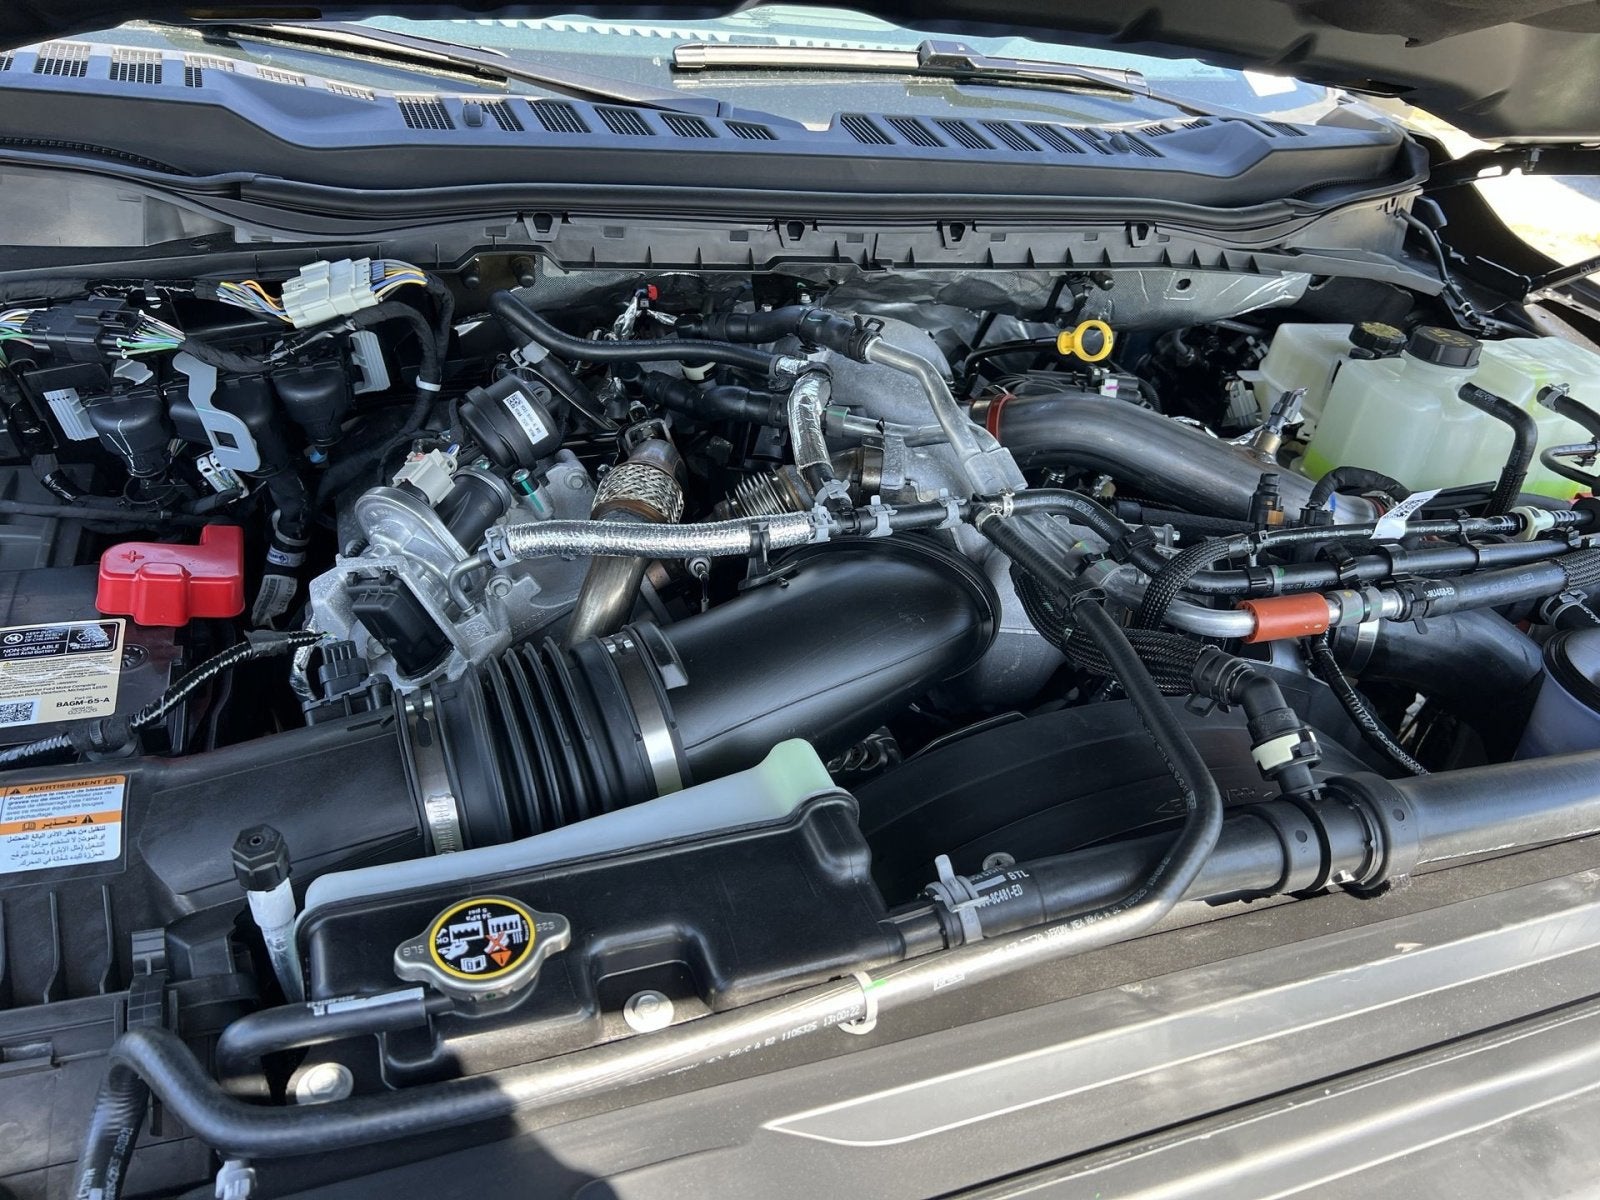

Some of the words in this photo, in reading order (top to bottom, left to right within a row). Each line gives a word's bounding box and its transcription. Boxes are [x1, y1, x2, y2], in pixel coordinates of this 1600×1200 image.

[3, 643, 60, 654] NON-SPILLABLE
[56, 697, 110, 708] BAGM-65-A
[27, 779, 101, 792] AVERTISSEMENT
